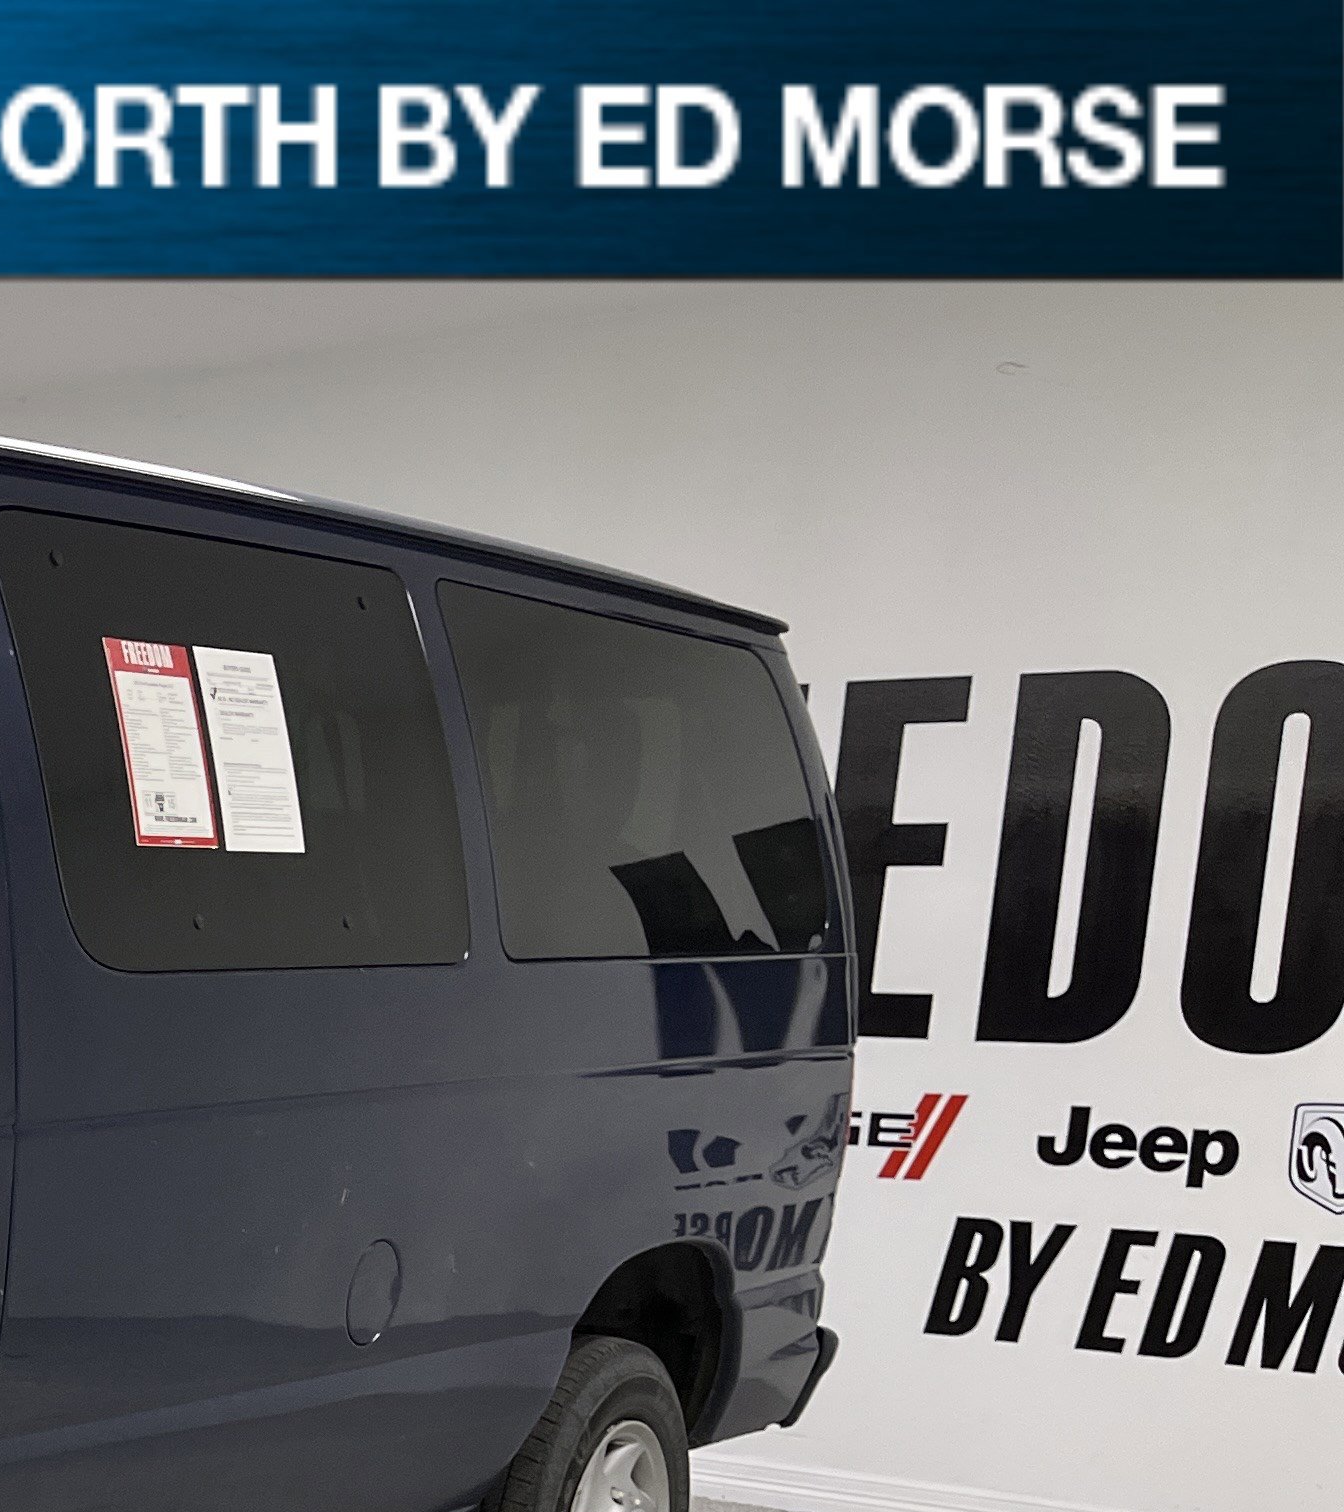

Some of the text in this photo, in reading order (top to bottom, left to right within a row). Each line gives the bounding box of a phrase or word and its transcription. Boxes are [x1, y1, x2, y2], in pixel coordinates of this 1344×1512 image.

[120, 640, 174, 669] FREEDOM
[801, 660, 1344, 1056] EDO
[1037, 1105, 1240, 1189] Jeep
[923, 1215, 1344, 1375] BY ED M
